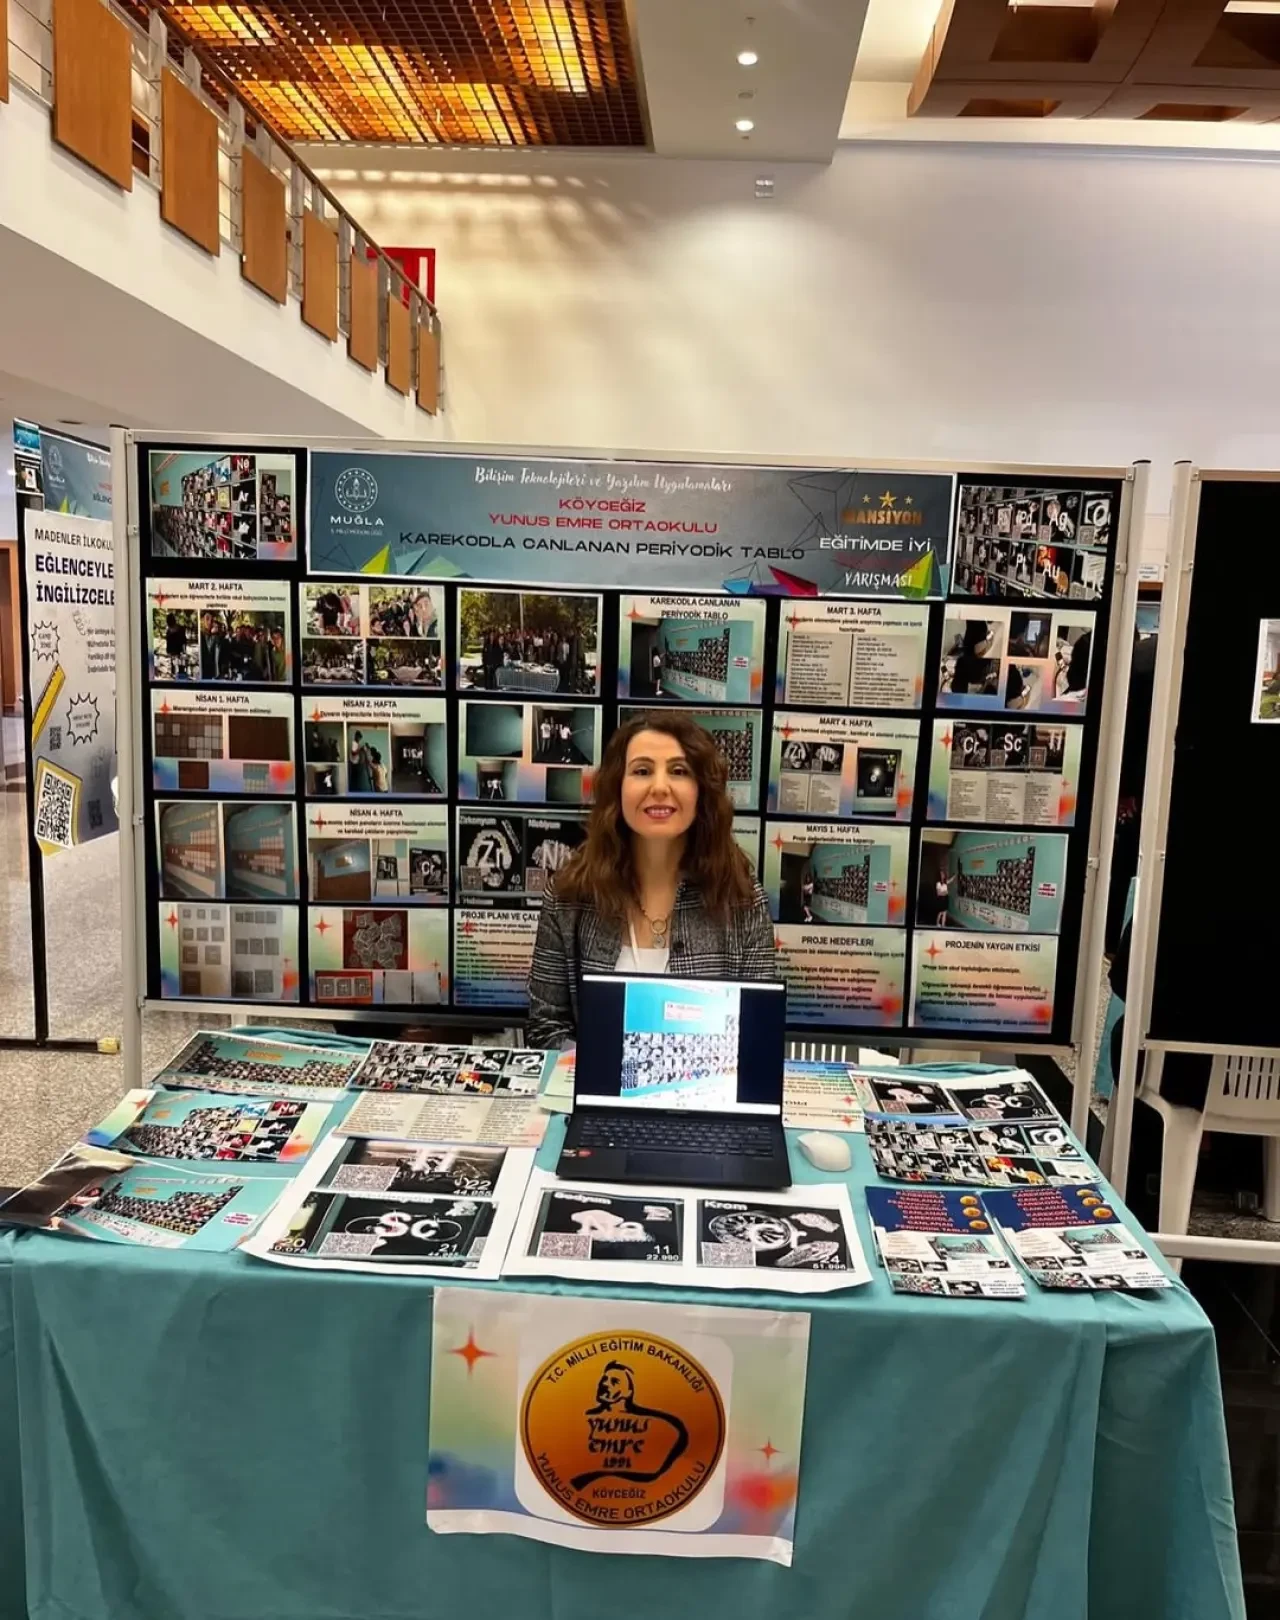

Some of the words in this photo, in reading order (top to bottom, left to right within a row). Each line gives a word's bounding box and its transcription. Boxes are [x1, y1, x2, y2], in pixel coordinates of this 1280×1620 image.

[474, 466, 515, 487] Bilişim
[519, 467, 587, 488] Teknolojileri
[590, 477, 602, 488] ve
[605, 473, 650, 494] Yazılım
[653, 474, 731, 494] Uygulamaları
[559, 498, 646, 513] KÖYCEĞİZ
[330, 514, 385, 526] MUĞLA
[489, 513, 551, 528] YUNUS
[556, 516, 603, 530] EMRE
[608, 517, 717, 534] ORTAOKULU
[35, 527, 81, 546] MADENLER
[400, 532, 516, 550] KAREKODLA
[523, 537, 630, 555] CANLANAN
[636, 540, 733, 558] PERİYODİK
[740, 546, 805, 561] TABLO
[819, 534, 903, 553] EĞİTİMDE
[909, 537, 931, 553] İYİ
[36, 551, 115, 580] EĞLENCEYLE
[188, 582, 209, 591] MART
[219, 583, 243, 592] HAFTA
[845, 571, 913, 591] YARIŞMASI
[650, 597, 697, 607] KAREKODLA
[698, 598, 740, 608] CANLANAN
[661, 609, 702, 619] PERİYODİK
[703, 612, 728, 621] TABLO
[827, 606, 847, 615] MART
[857, 608, 882, 617] HAFTA
[195, 694, 217, 703] NİSAN
[226, 696, 250, 704] HAFTA
[343, 699, 365, 708] NİSAN
[373, 701, 397, 709] HAFTA
[819, 717, 840, 727] MART
[849, 719, 873, 728] HAFTA
[1003, 733, 1022, 752] Sc
[350, 808, 372, 817] NİSAN
[380, 809, 403, 818] HAFTA
[806, 824, 828, 834] MAYIS
[837, 826, 860, 835] HAFTA
[461, 911, 486, 920] PROJE
[487, 912, 510, 921] PLANI
[511, 912, 521, 921] VE
[801, 935, 829, 945] PROJE
[830, 937, 874, 947] HEDEFLERİ
[945, 939, 984, 949] PROJENİN
[986, 942, 1014, 951] YAYGIN
[1015, 942, 1041, 952] ETKİSİ
[704, 1200, 748, 1211] Krom
[374, 1211, 440, 1238] Sc
[438, 1243, 458, 1252] 21
[653, 1245, 671, 1255] 11
[818, 1256, 841, 1264] 24
[548, 1367, 567, 1384] T.C.
[566, 1344, 598, 1367] MİLLİ
[600, 1338, 643, 1354] EĞİTİM
[646, 1344, 704, 1393] BAKANLIĞI
[537, 1452, 574, 1501] YUNUS
[575, 1497, 619, 1520] EMRE
[623, 1461, 707, 1520] ORTAOKULU
[592, 1487, 646, 1500] KÖYCEĞİZ
